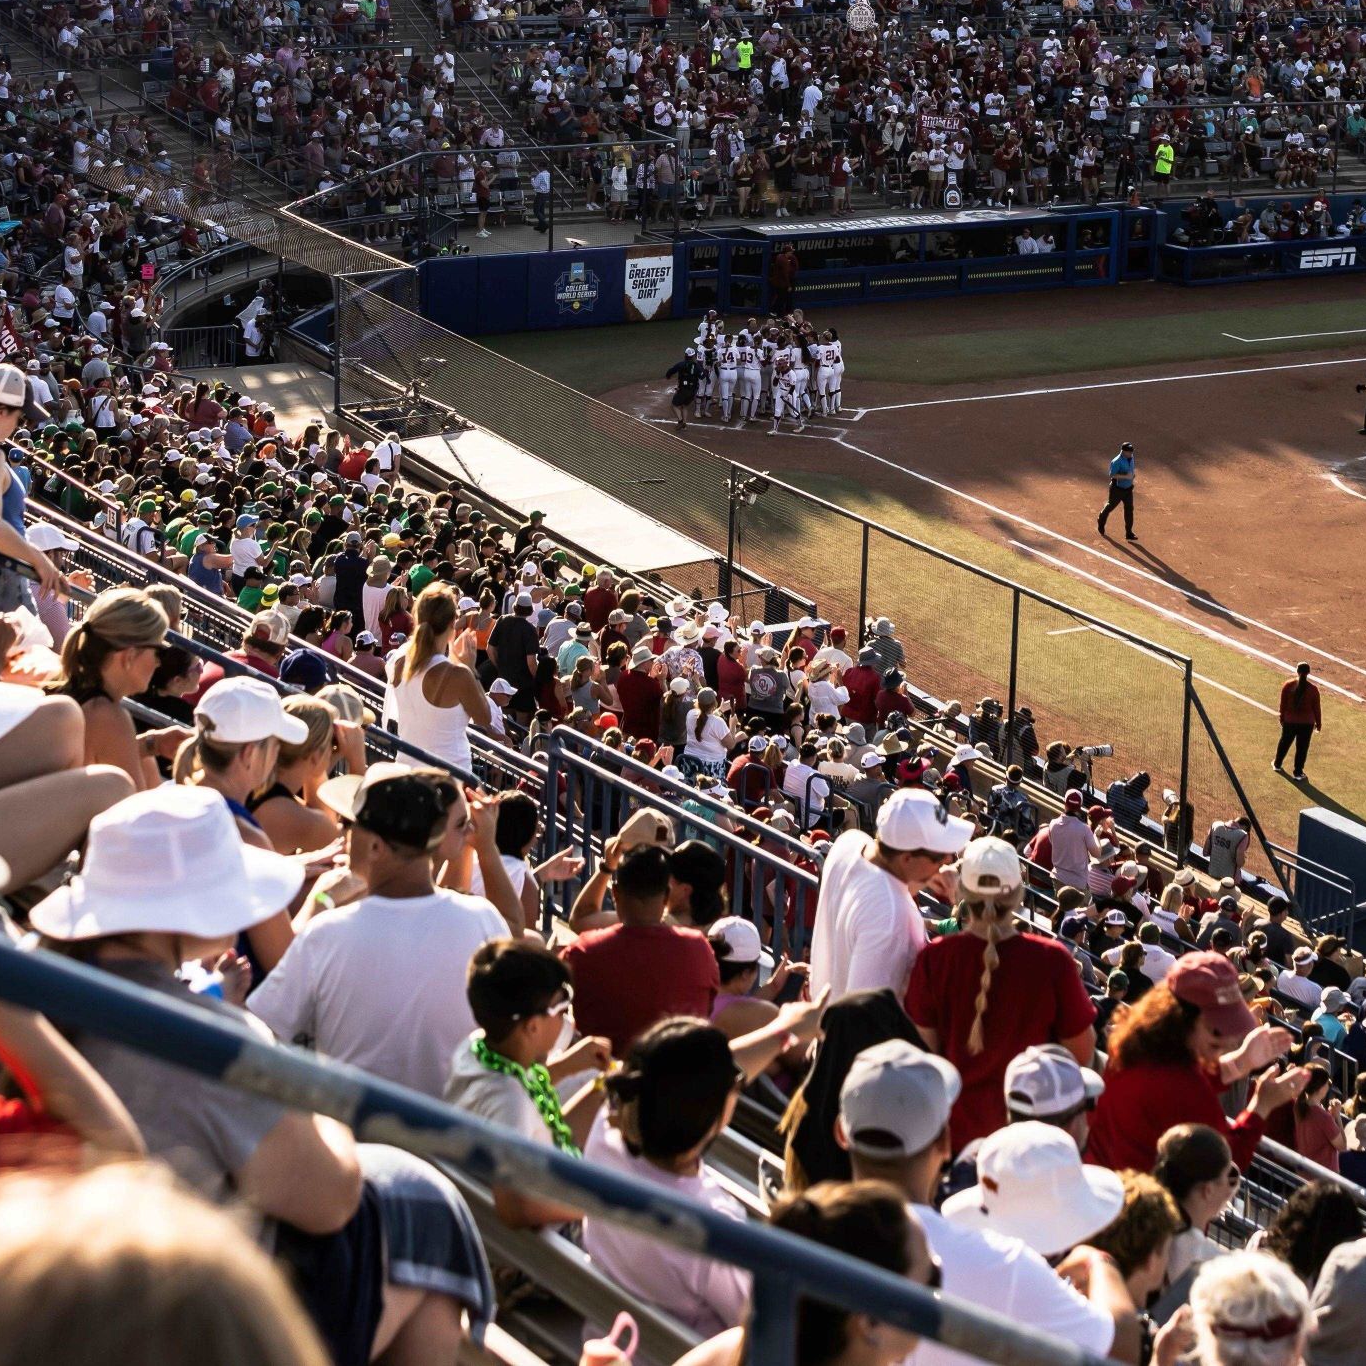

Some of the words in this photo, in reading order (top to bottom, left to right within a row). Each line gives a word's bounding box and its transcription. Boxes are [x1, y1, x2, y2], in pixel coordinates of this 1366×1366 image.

[1299, 246, 1356, 269] ESPN
[629, 266, 671, 279] GREATEST
[632, 278, 658, 290] SHOW
[557, 292, 576, 300] WORLD
[577, 290, 597, 298] SERIES
[637, 288, 658, 299] DIRT
[825, 350, 835, 361] 21
